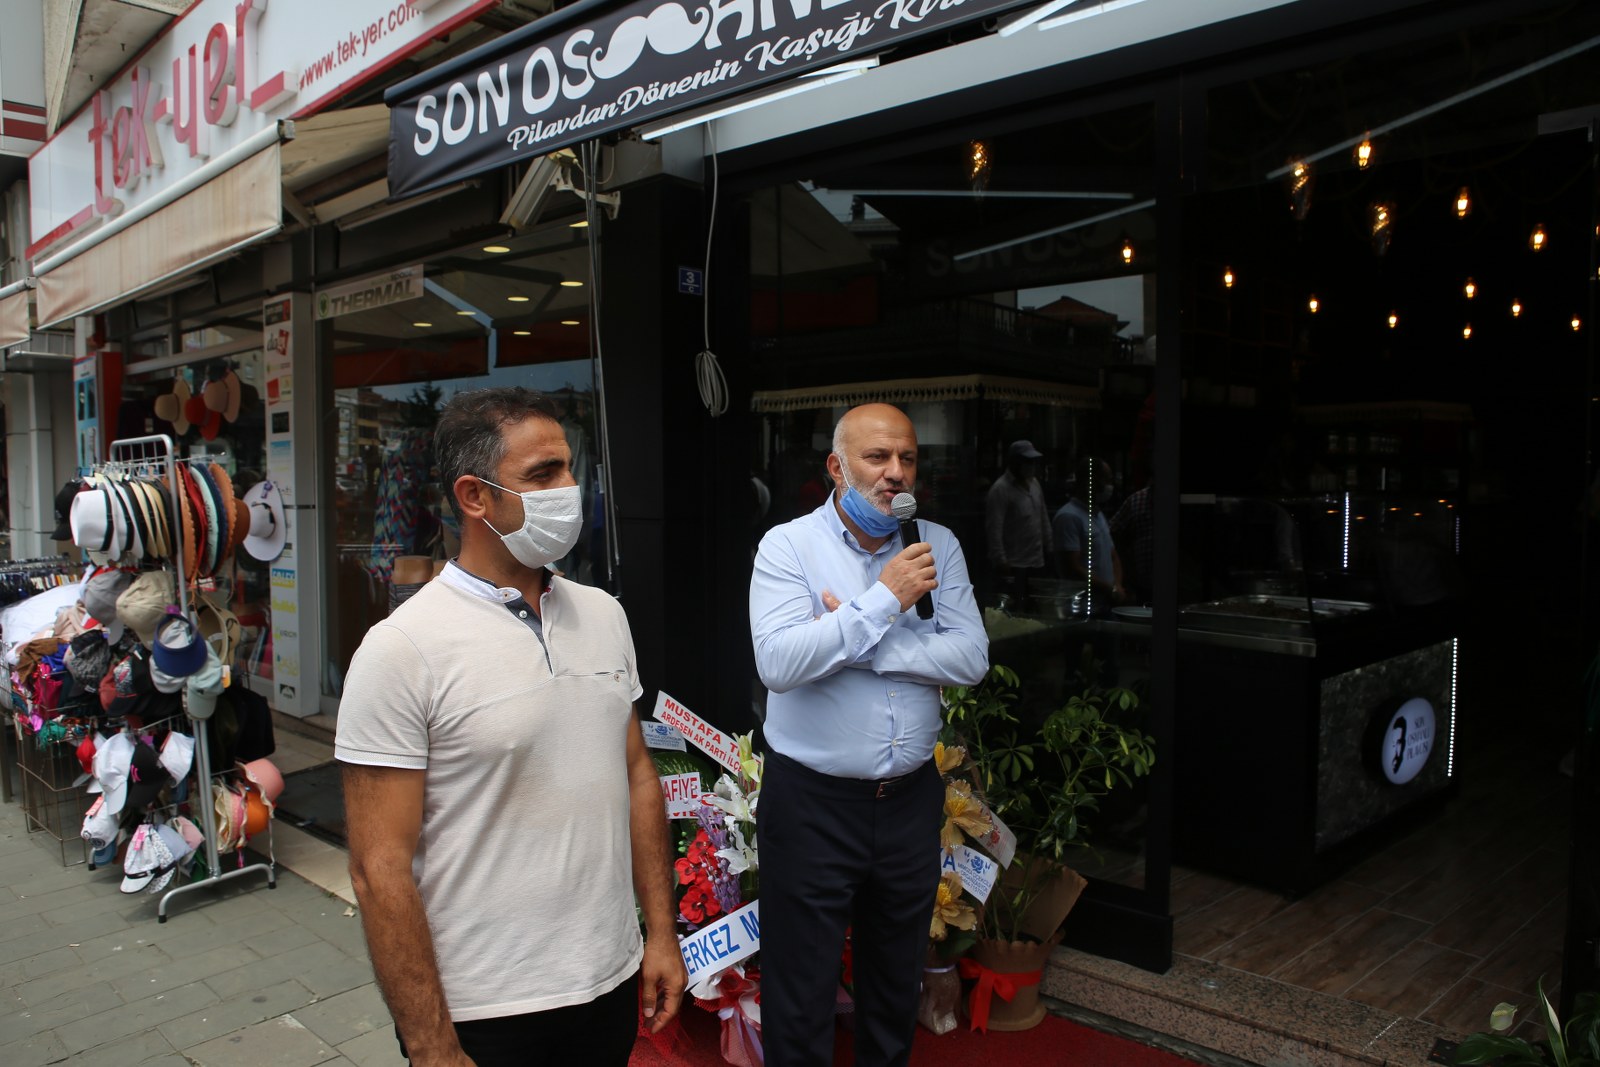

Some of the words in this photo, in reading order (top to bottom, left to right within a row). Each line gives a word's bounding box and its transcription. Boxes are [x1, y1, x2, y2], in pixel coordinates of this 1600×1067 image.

[507, 104, 618, 151] Pilavdan
[617, 58, 742, 116] Dönenin
[744, 12, 875, 72] Kaşığı
[413, 63, 510, 156] SON
[331, 279, 416, 317] THERMAL
[686, 271, 695, 284] 3
[661, 711, 693, 737] ARDESEN
[694, 733, 704, 746] AK
[704, 741, 727, 761] PARTİ
[664, 698, 721, 744] MUSTAFA
[682, 923, 740, 975] ERKEZ
[739, 910, 760, 942] M
